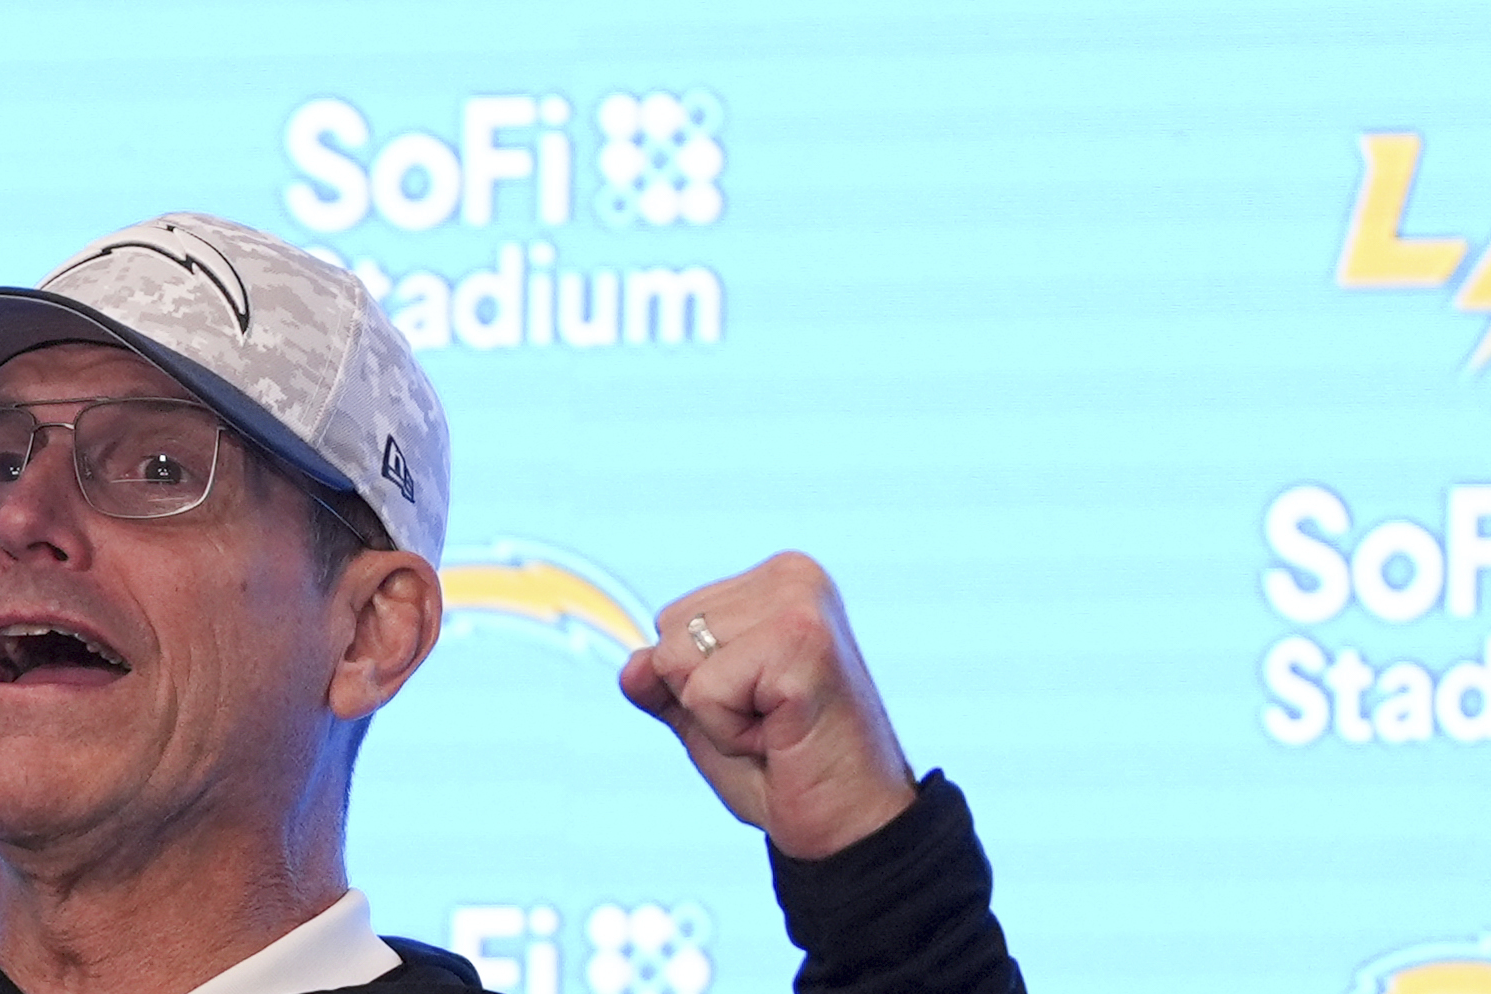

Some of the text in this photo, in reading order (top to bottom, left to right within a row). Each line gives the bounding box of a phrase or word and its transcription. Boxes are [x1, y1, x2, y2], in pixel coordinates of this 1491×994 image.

[286, 96, 570, 233] SoFi
[306, 247, 723, 350] adium
[1335, 132, 1491, 366] L
[1264, 486, 1491, 624] SoF
[1264, 637, 1491, 745] Stad
